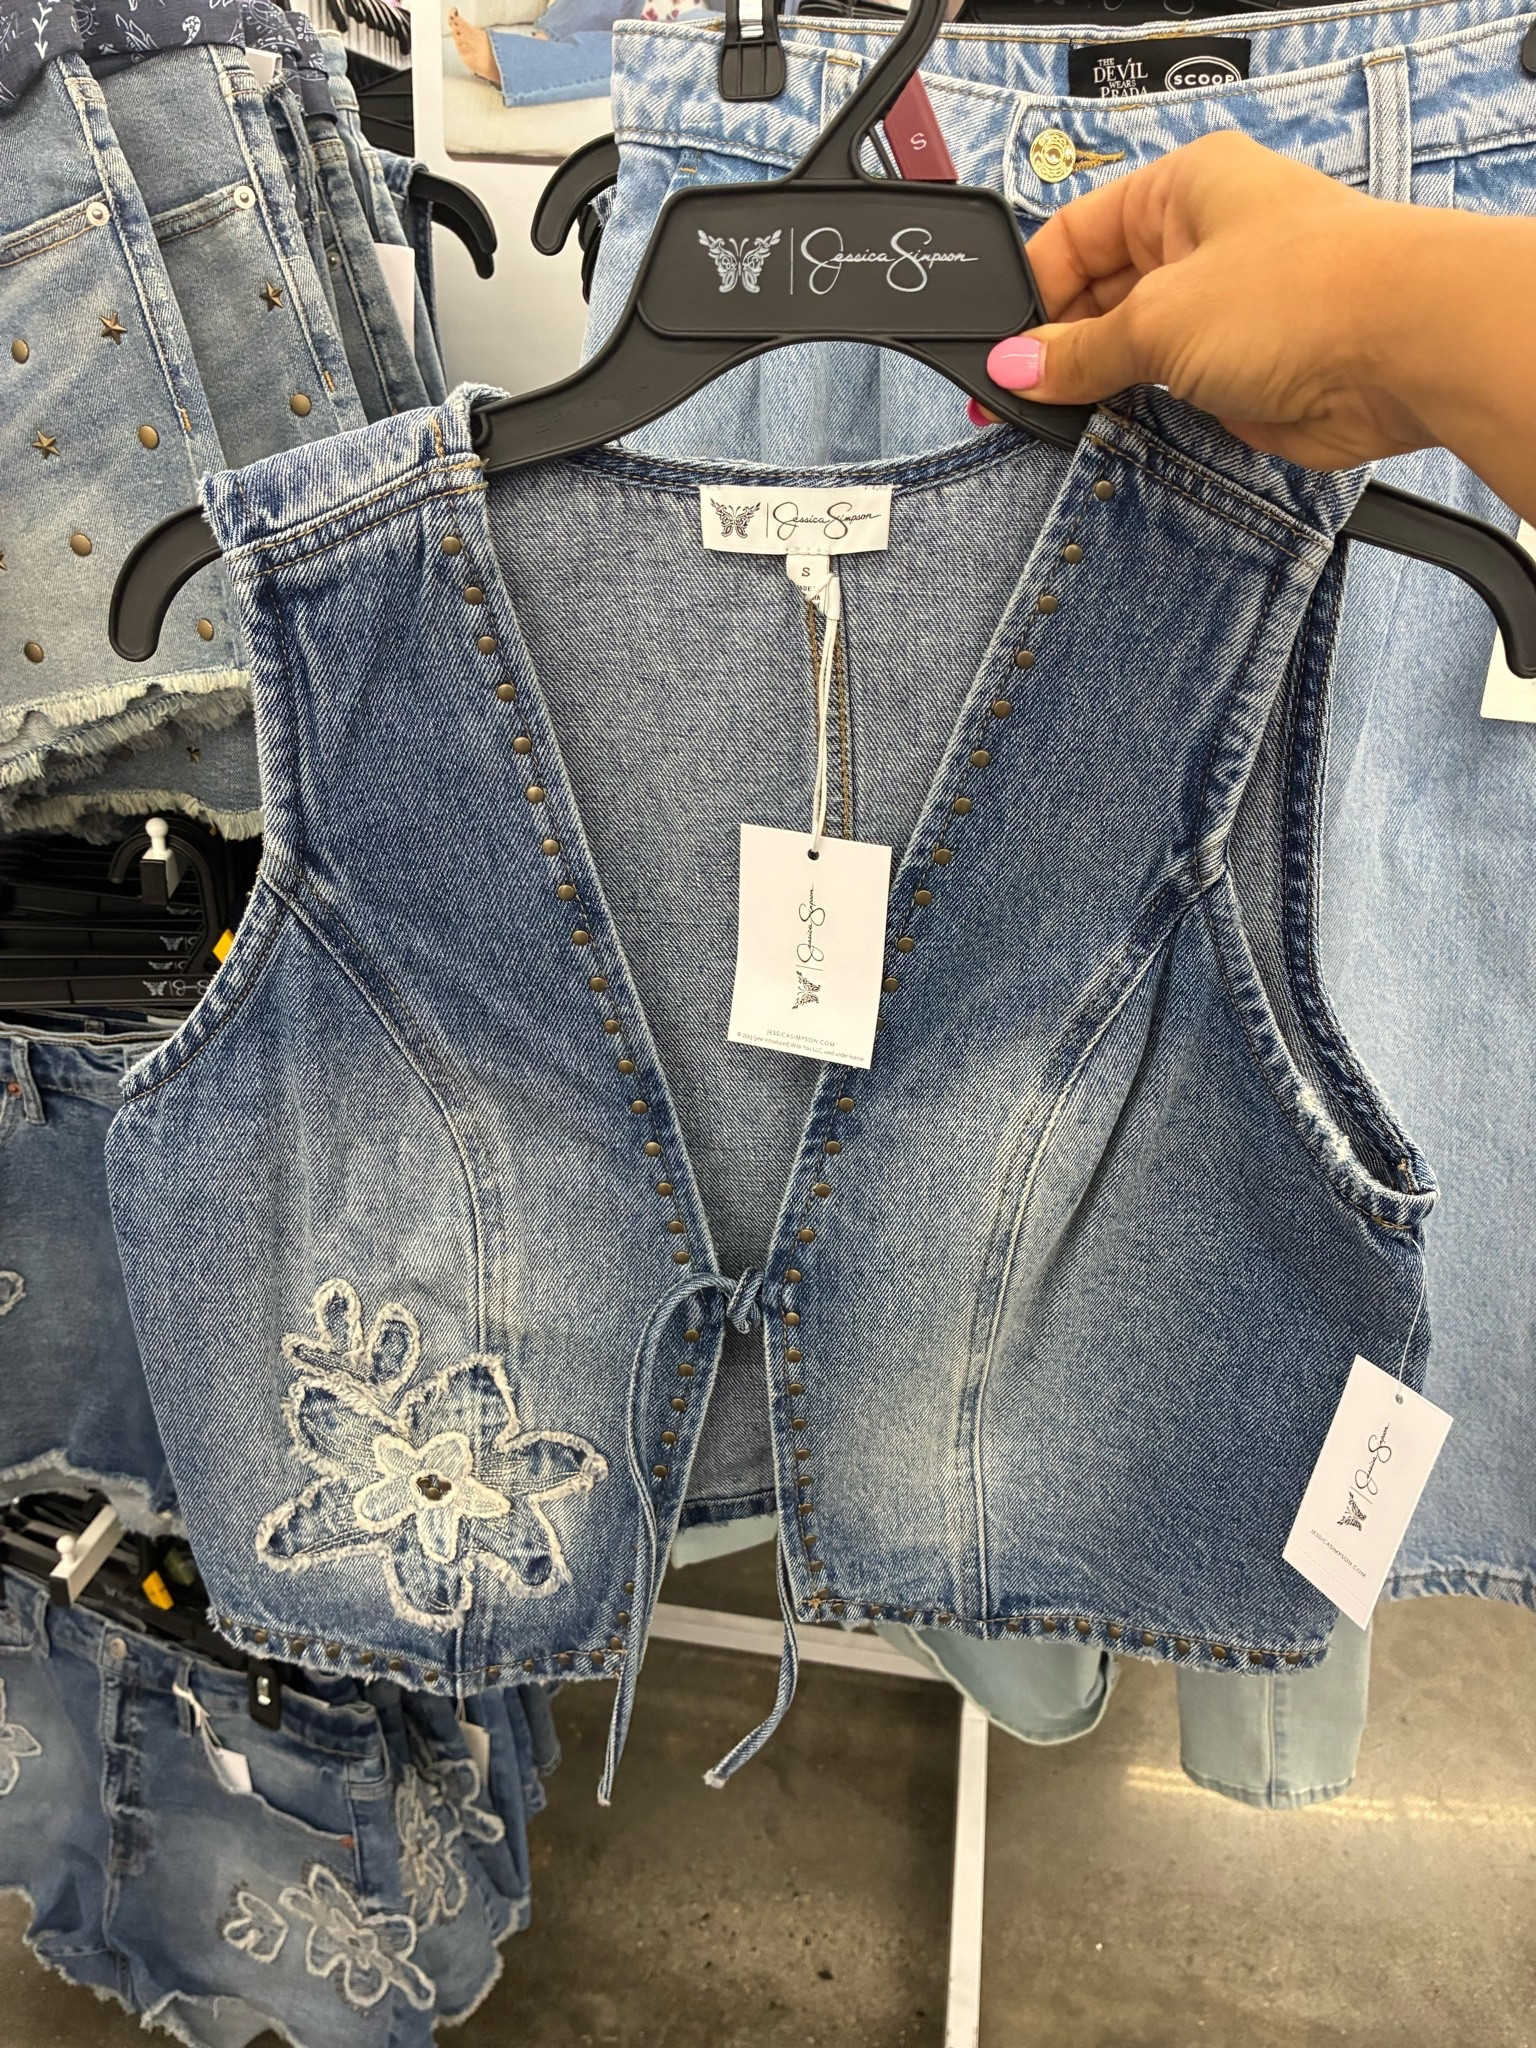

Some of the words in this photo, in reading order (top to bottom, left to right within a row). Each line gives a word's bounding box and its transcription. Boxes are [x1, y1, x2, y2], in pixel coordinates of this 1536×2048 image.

[1097, 57, 1115, 66] THE
[1093, 57, 1149, 84] DEVIL
[1109, 79, 1137, 89] WEARS
[1173, 74, 1235, 85] SCOOP
[1100, 86, 1147, 98] PRADA
[910, 133, 928, 151] S
[800, 227, 894, 295] Jessica
[886, 227, 979, 292] Simpson
[772, 501, 830, 540] Jessica
[824, 501, 882, 539] Simpson
[801, 567, 811, 577] S
